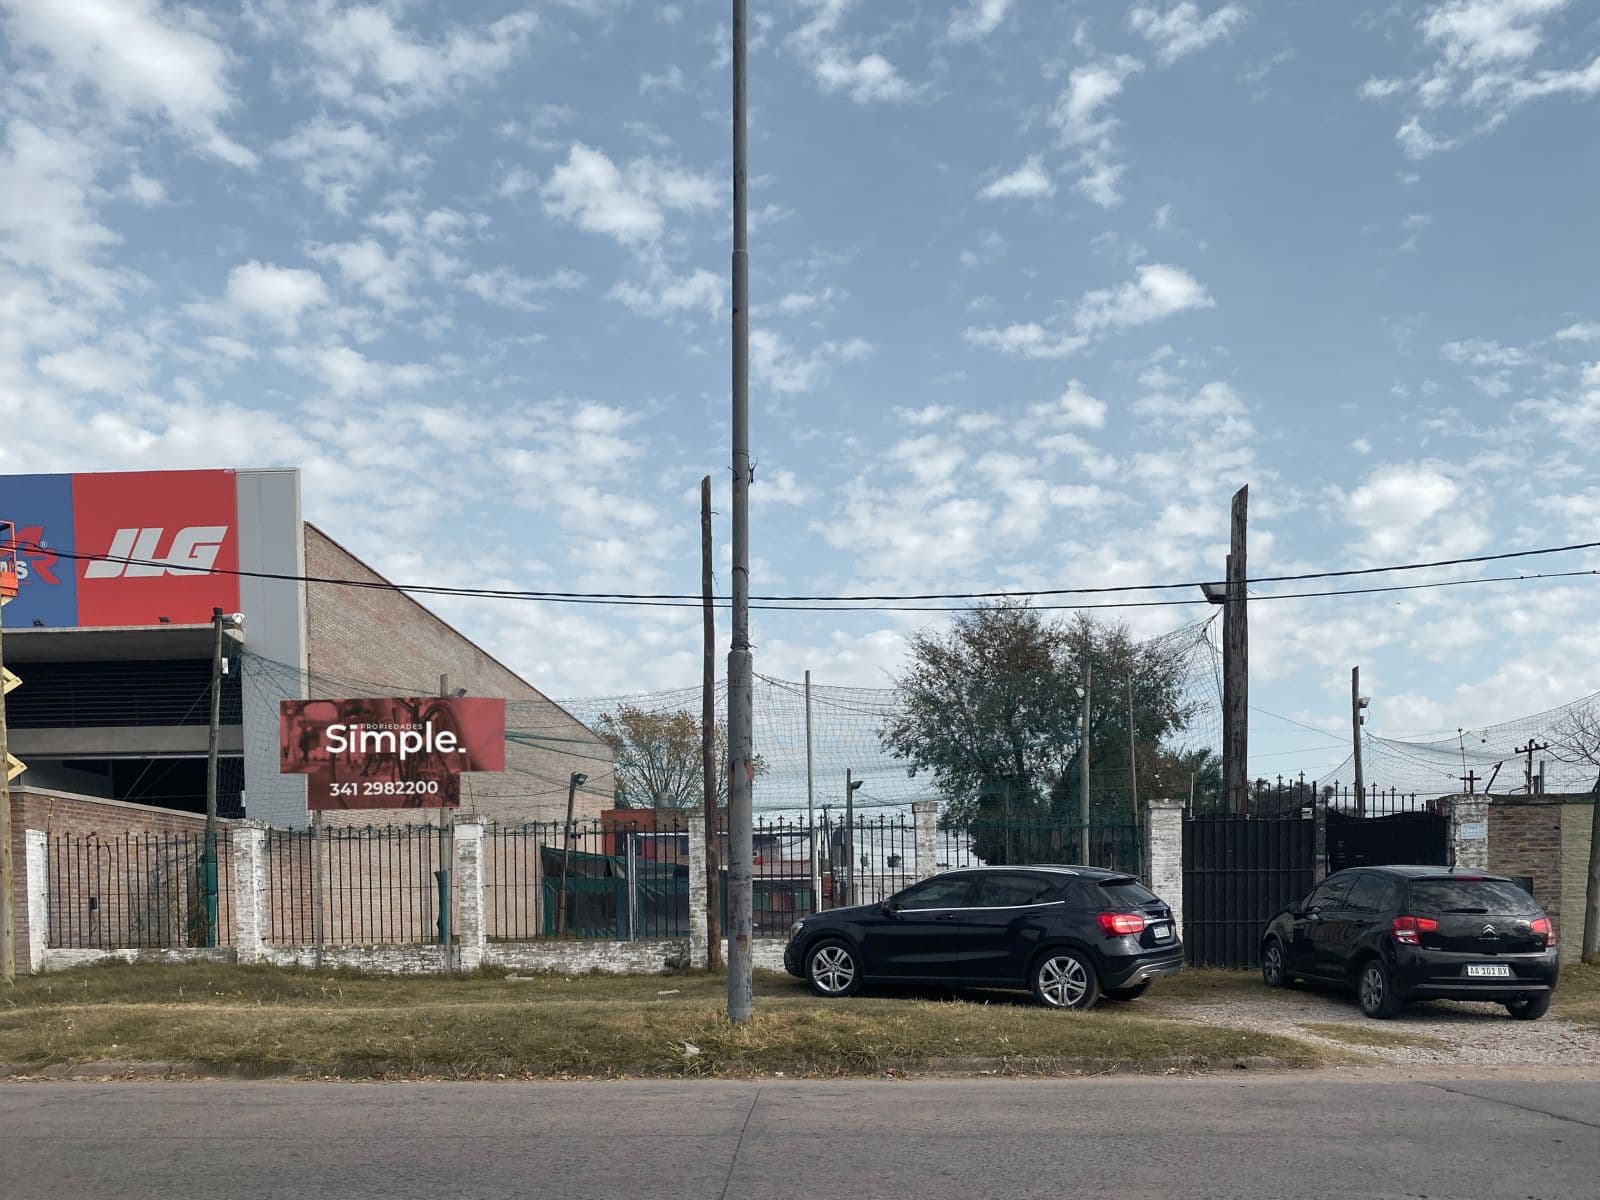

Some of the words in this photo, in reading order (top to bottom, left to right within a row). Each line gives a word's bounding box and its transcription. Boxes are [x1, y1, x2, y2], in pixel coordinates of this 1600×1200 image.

[84, 525, 228, 579] JLG
[325, 721, 467, 760] Simple.
[329, 782, 358, 796] 341
[363, 780, 438, 796] 2982200
